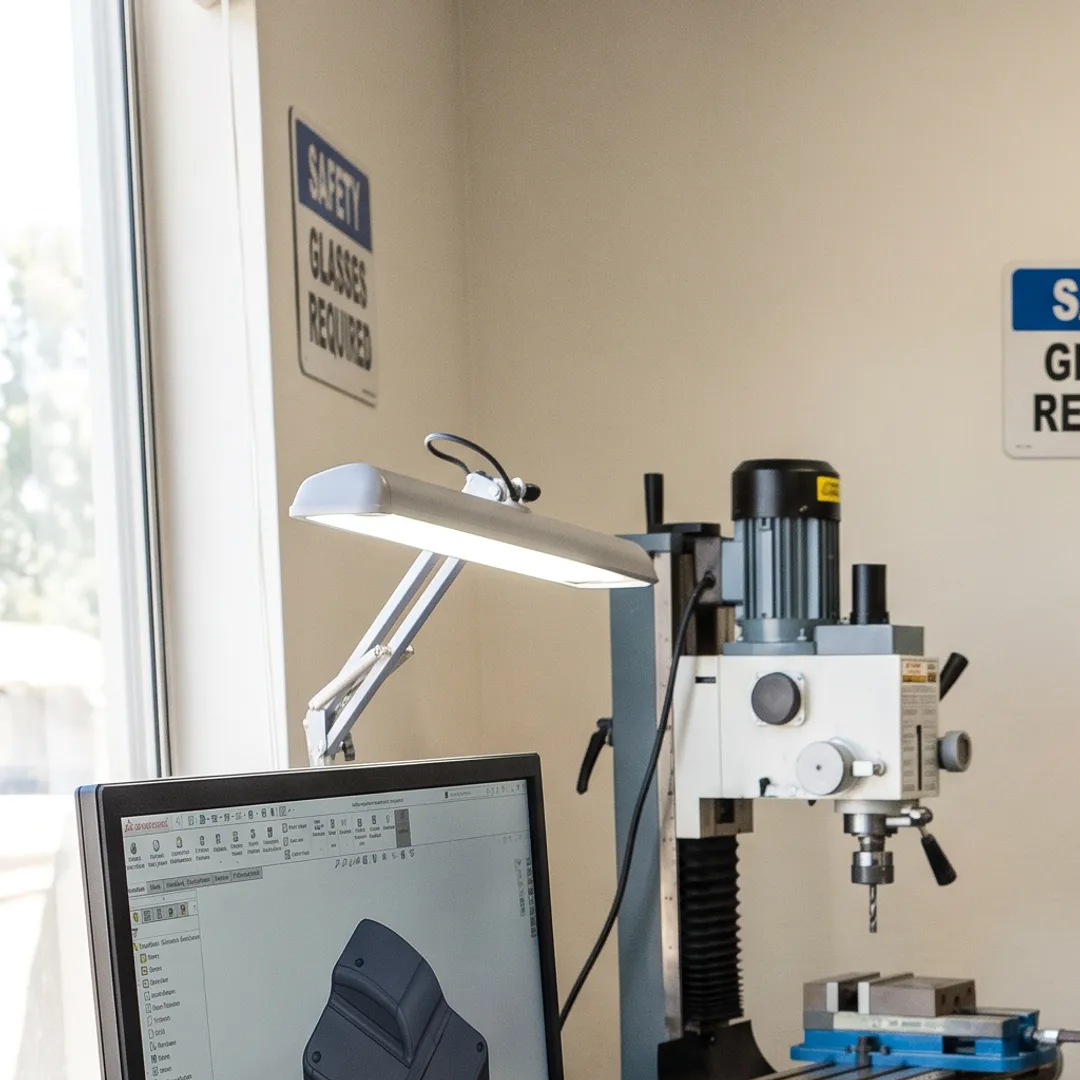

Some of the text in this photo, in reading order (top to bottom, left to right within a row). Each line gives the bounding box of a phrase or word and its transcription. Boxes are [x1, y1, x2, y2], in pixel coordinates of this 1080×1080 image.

[307, 142, 361, 232] SAFETY
[308, 226, 368, 310] GLASSES
[307, 290, 373, 372] REQUIRED
